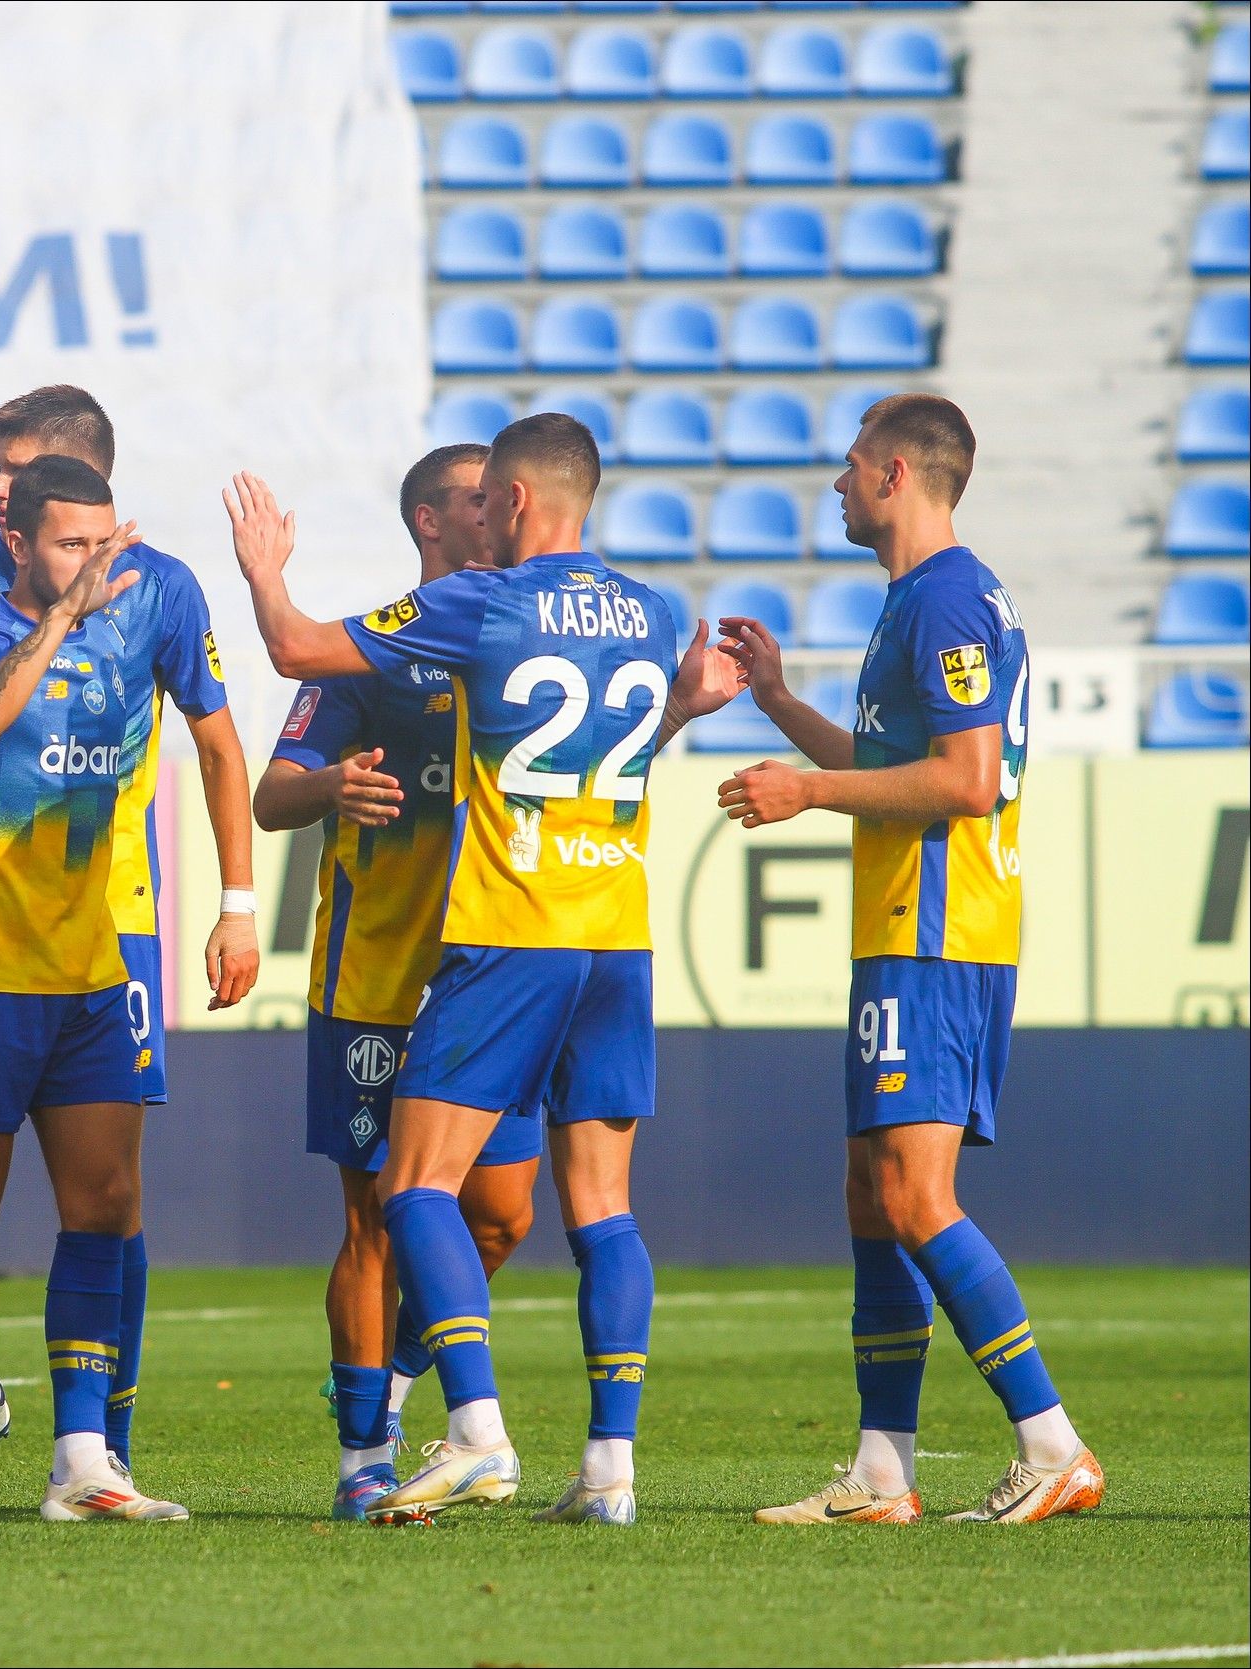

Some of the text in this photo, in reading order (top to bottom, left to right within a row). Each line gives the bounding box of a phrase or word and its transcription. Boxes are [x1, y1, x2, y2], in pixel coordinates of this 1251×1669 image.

[538, 591, 649, 639] КАБАЄВ
[1048, 674, 1108, 714] 13
[497, 655, 669, 802] 22
[553, 832, 645, 868] vbet
[858, 997, 906, 1064] 91
[350, 1039, 391, 1081] MG
